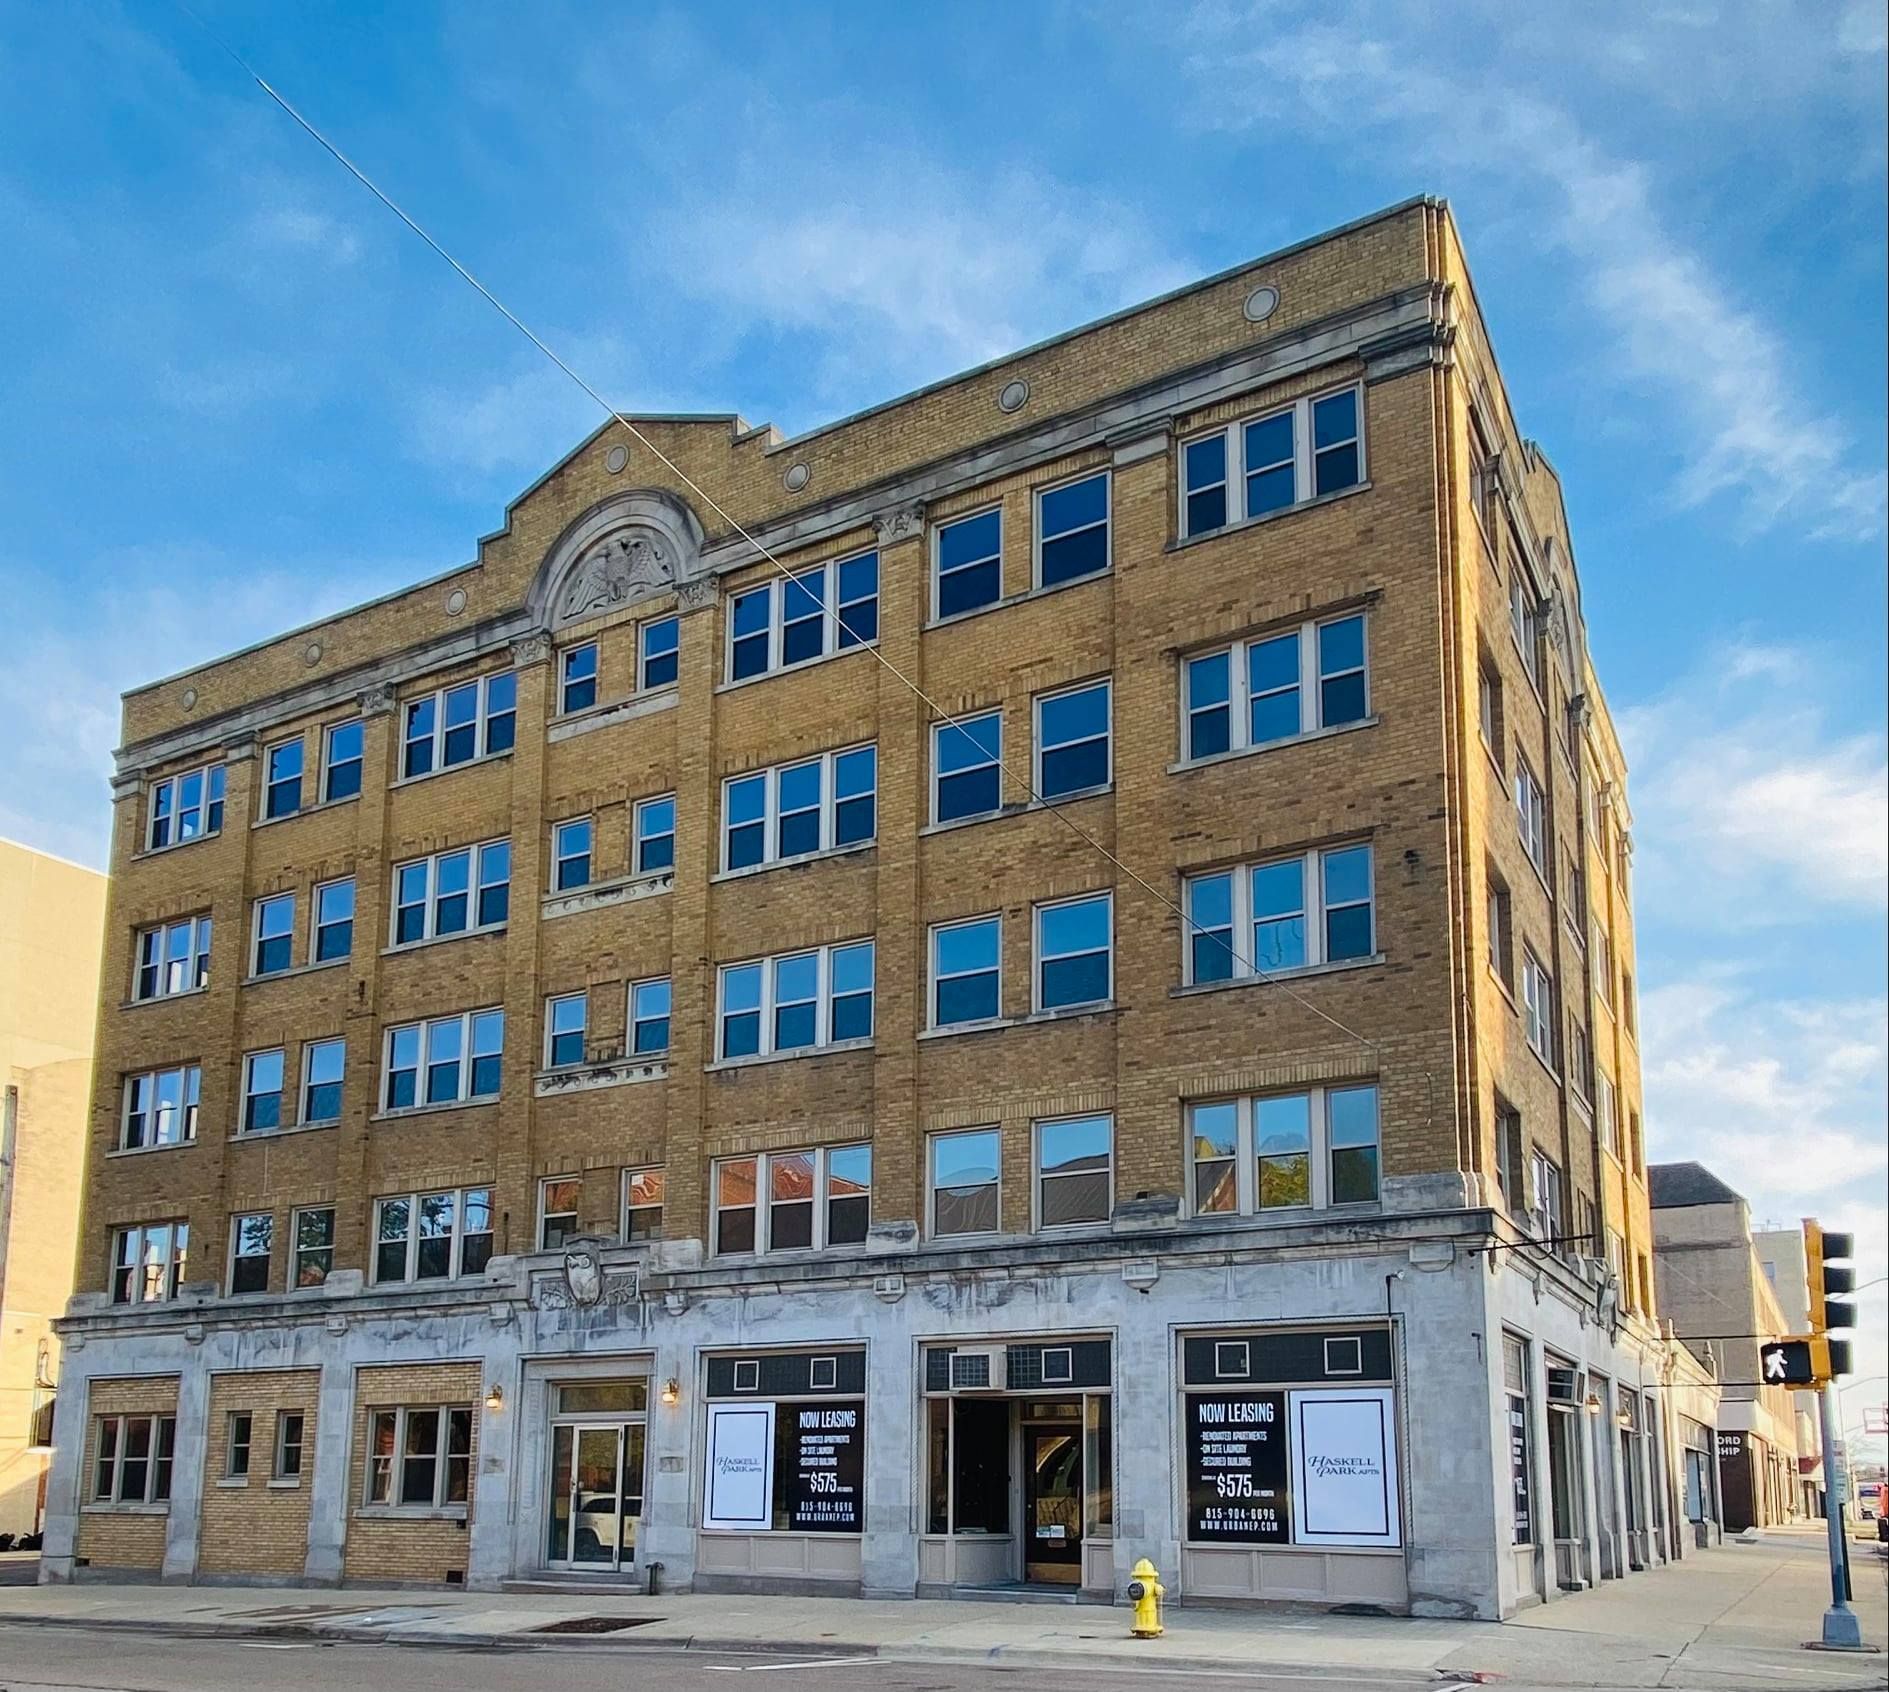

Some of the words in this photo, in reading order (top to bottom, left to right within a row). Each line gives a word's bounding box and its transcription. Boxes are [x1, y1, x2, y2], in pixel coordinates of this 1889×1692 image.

[799, 1411, 820, 1428] NOW
[821, 1410, 856, 1428] LEASING
[1199, 1403, 1225, 1423] NOW
[1228, 1402, 1274, 1423] LEASING
[716, 1456, 760, 1466] HASKELL
[1308, 1456, 1376, 1467] HASKELL
[720, 1465, 750, 1475] PARK
[1316, 1467, 1358, 1478] PARK
[810, 1471, 837, 1493] $575
[1216, 1472, 1253, 1498] $575
